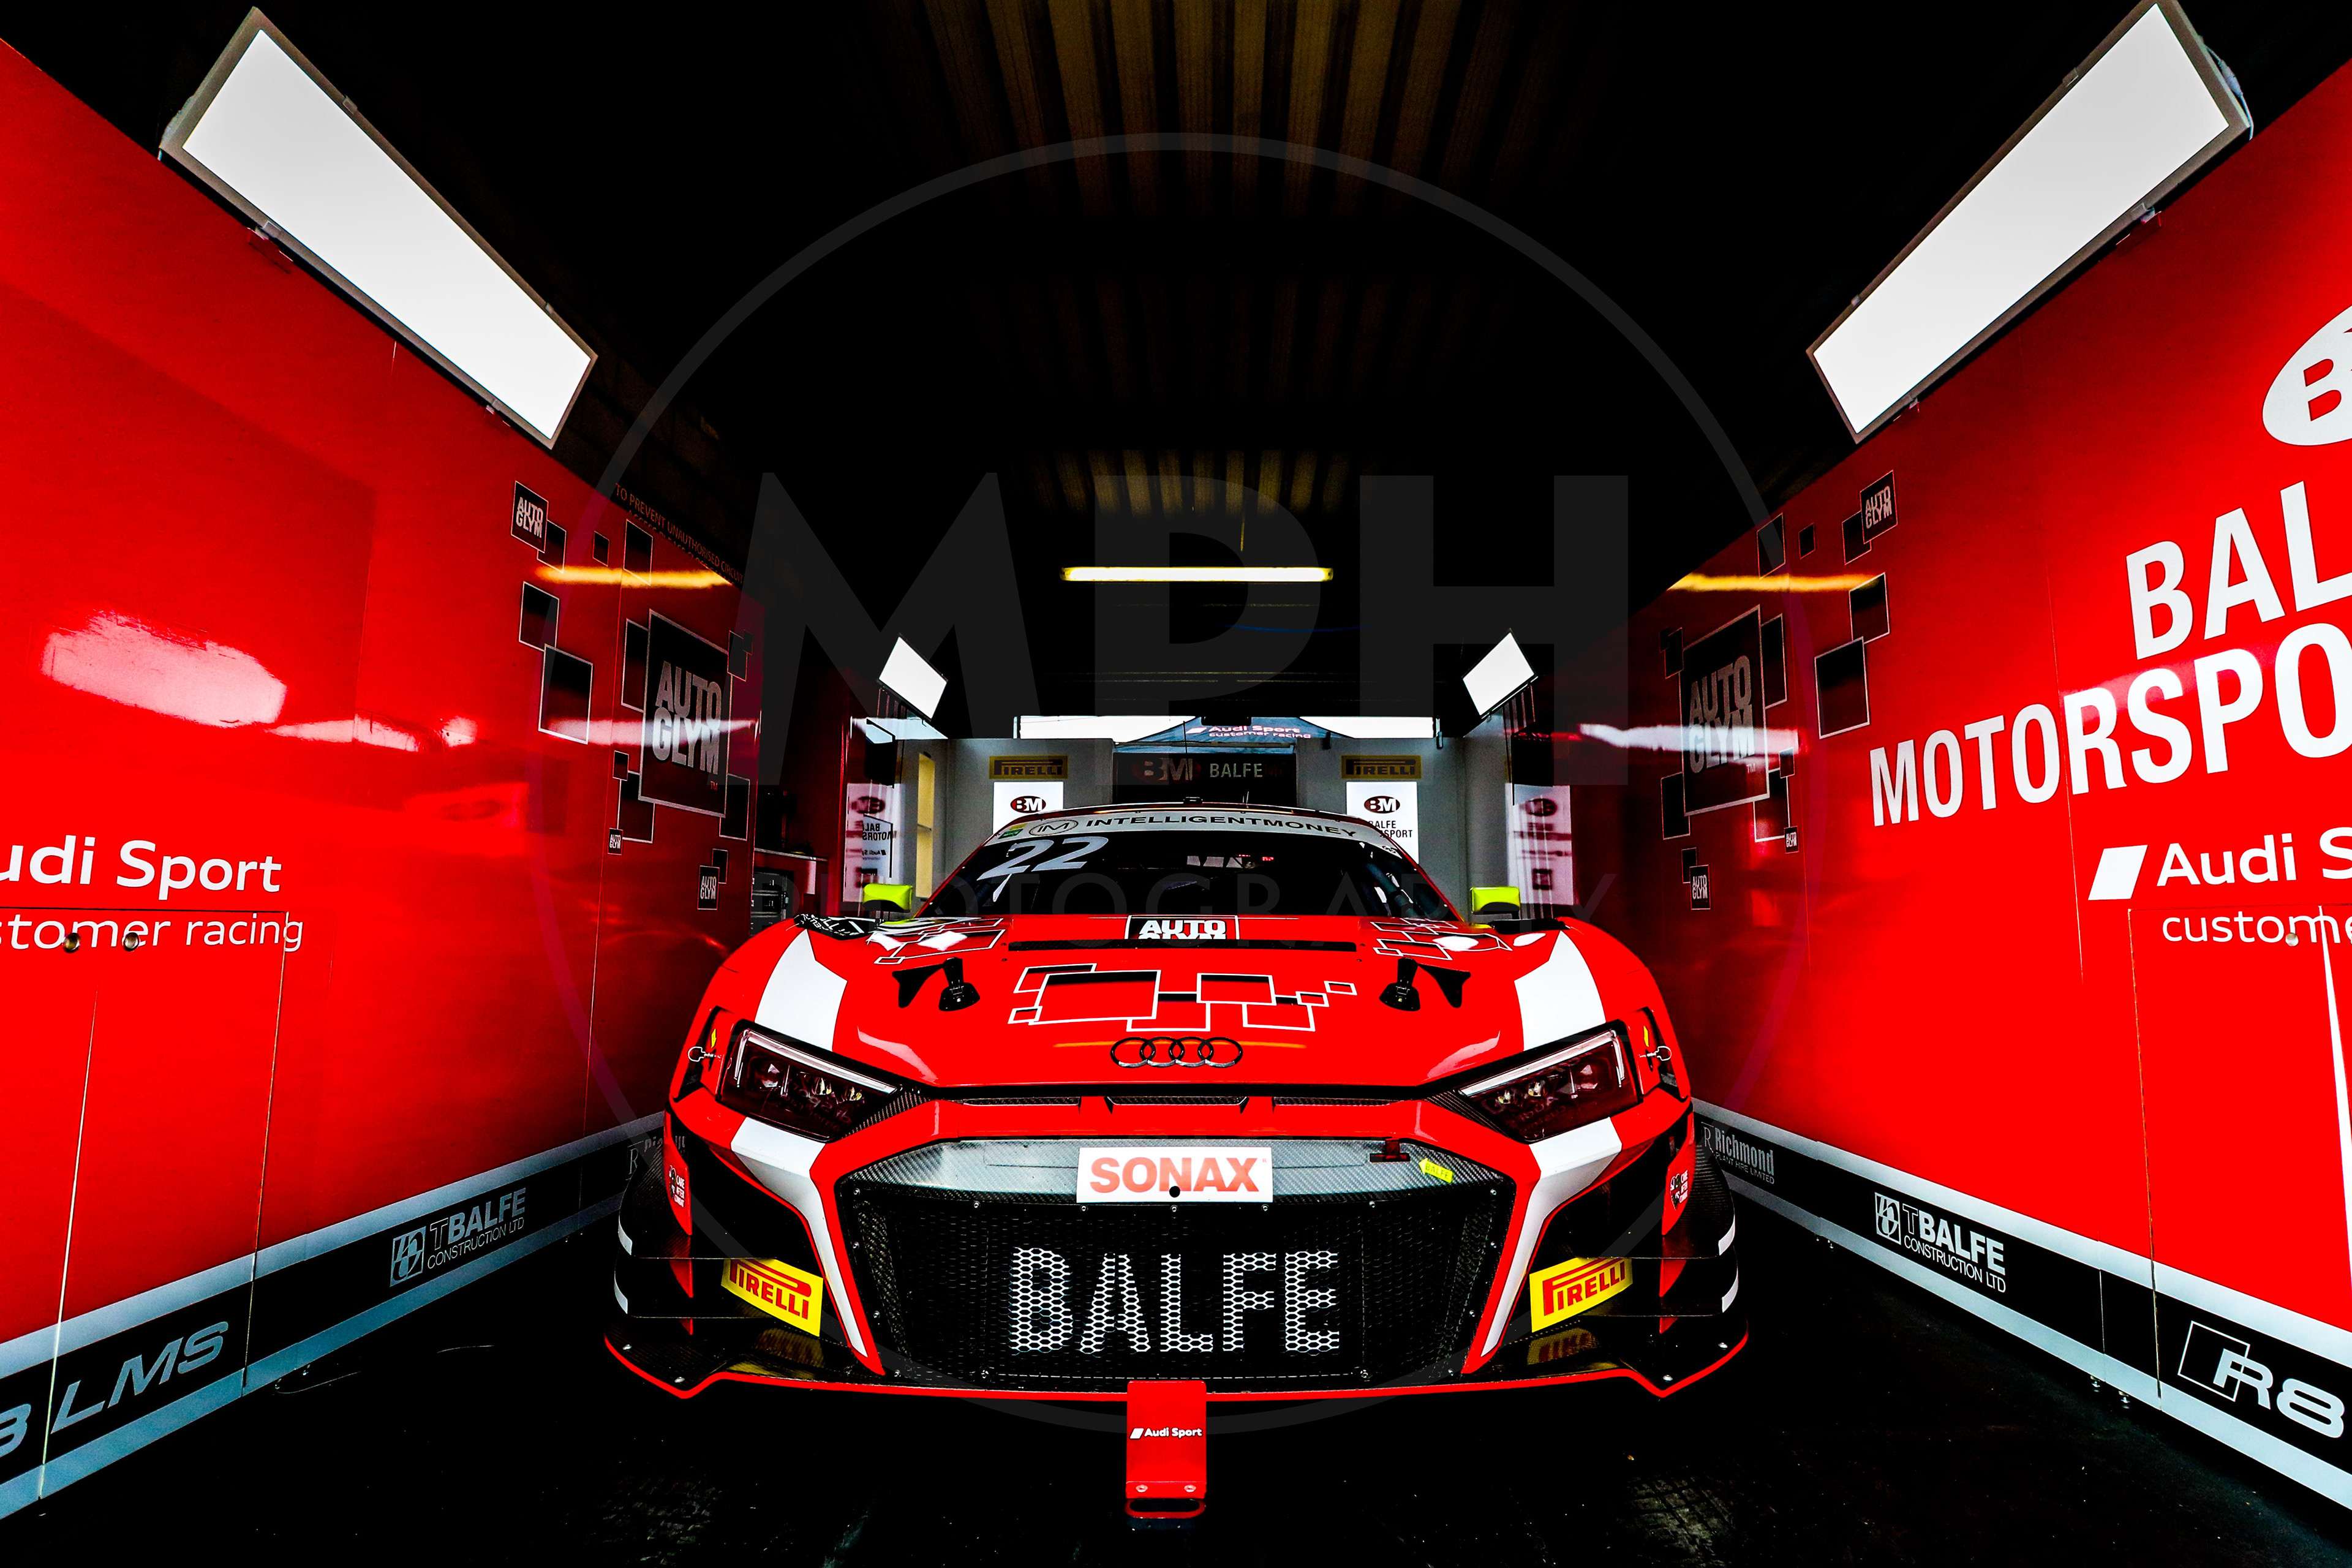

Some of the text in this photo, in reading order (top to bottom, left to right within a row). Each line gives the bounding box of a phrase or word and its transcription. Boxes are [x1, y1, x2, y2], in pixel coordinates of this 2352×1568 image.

[517, 496, 543, 520] AUTO
[1865, 486, 1891, 513] AUTO
[1865, 503, 1892, 529] GLYM
[516, 510, 542, 538] GLYM
[616, 483, 744, 584] TO PREVENT UNAUTHORISED CIRCUIT
[655, 660, 722, 732] AUTO
[1689, 655, 1752, 725] AUTO
[652, 707, 719, 775] GLYM
[1252, 725, 1300, 734] Sport
[1689, 704, 1755, 774] GLYM
[993, 760, 1063, 775] PIRELLI
[1210, 763, 1263, 778] BALFE
[1346, 759, 1415, 775] PIRELLI
[1015, 798, 1042, 812] BM
[1370, 798, 1396, 812] BM
[610, 834, 621, 843] AUTO
[1086, 816, 1357, 837] INTELLIGENTMONEY
[116, 840, 282, 900] Sport
[977, 837, 1109, 881] 22
[2157, 833, 2296, 886] Audi
[700, 886, 716, 900] GLYM
[701, 876, 717, 888] AUTO
[1692, 874, 1707, 888] AUTO
[1692, 886, 1708, 900] GLYM
[186, 913, 303, 952] racing
[1139, 920, 1226, 934] AUTO
[2162, 911, 2352, 944] custom
[1715, 1127, 1774, 1176] Richmond
[1090, 1156, 1259, 1193] SONAX
[1426, 1163, 1449, 1179] BALFE
[1716, 1152, 1734, 1166] PLANT
[1750, 1167, 1774, 1185] LIMITED
[428, 1217, 525, 1269] CONSTRUCTION LTD
[1904, 1235, 2006, 1293] CONSTRUCTION LTD
[729, 1259, 812, 1320] PIRELLI
[1009, 1246, 1340, 1356] BALFE
[1542, 1257, 1626, 1316] PIRELLI
[50, 1321, 228, 1435] LMS
[2213, 1348, 2345, 1438] R8
[1144, 1427, 1202, 1438] Audi Sport
